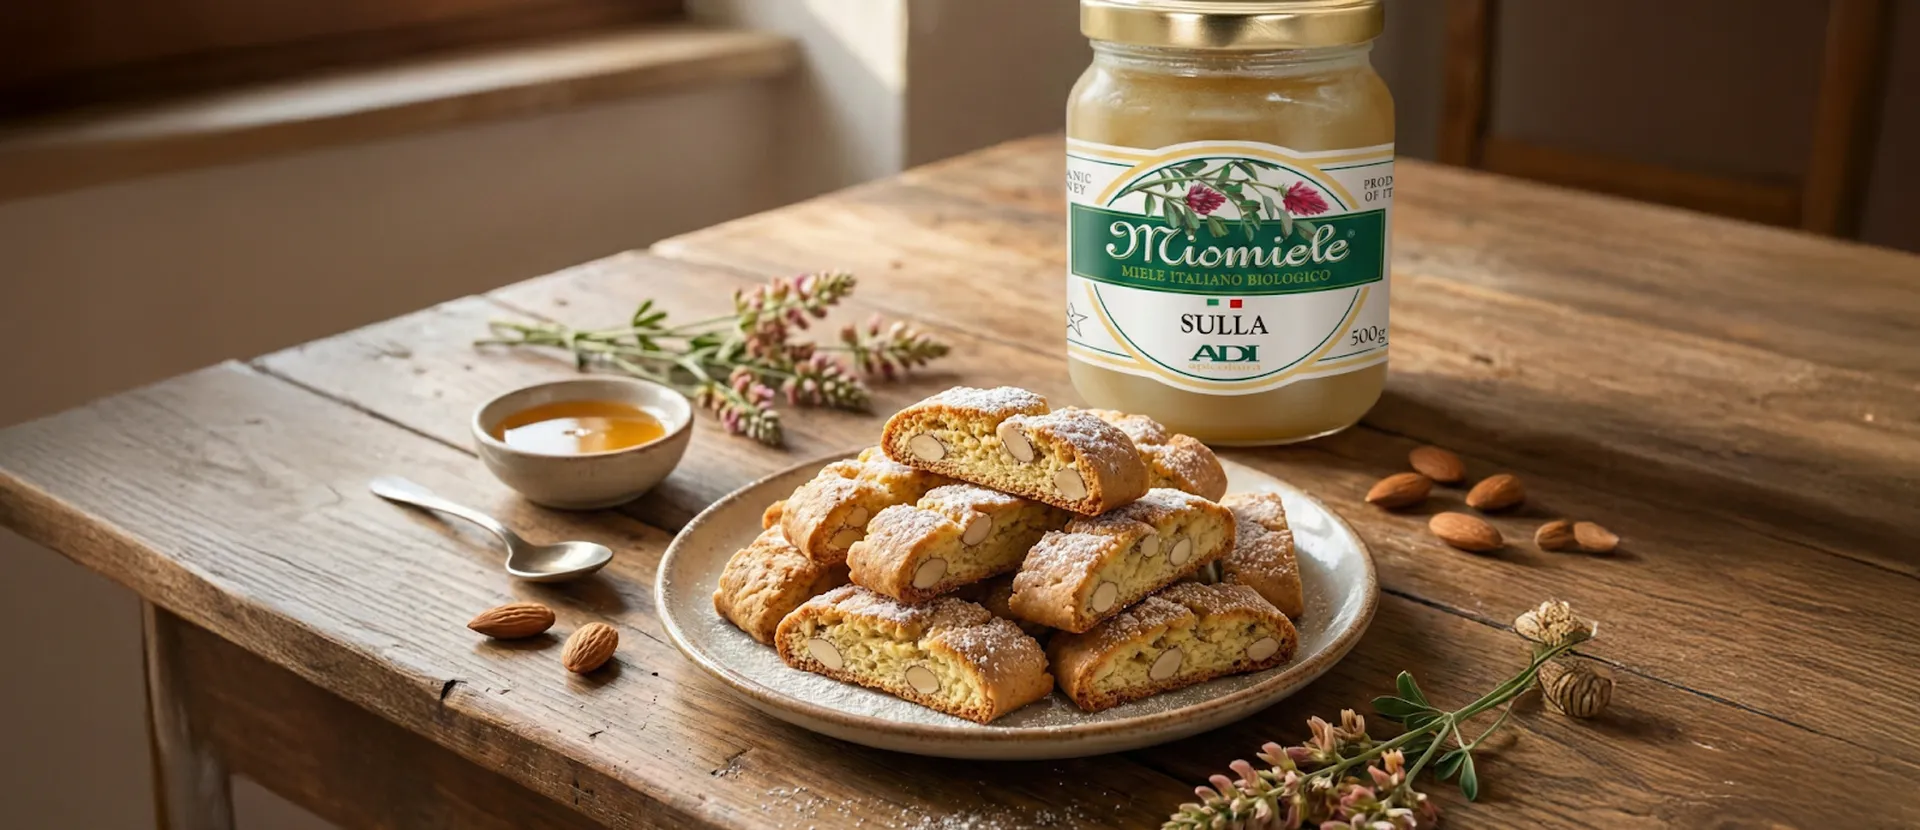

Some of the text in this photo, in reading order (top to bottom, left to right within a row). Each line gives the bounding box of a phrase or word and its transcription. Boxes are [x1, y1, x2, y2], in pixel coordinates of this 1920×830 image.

[1365, 191, 1379, 202] OF
[1105, 220, 1350, 269] Miomiele
[1121, 264, 1331, 286] MIELE ITALIANO BIOLOGICO
[1180, 313, 1269, 335] SULLA
[1350, 325, 1386, 346] 500g
[1188, 344, 1260, 362] ADI
